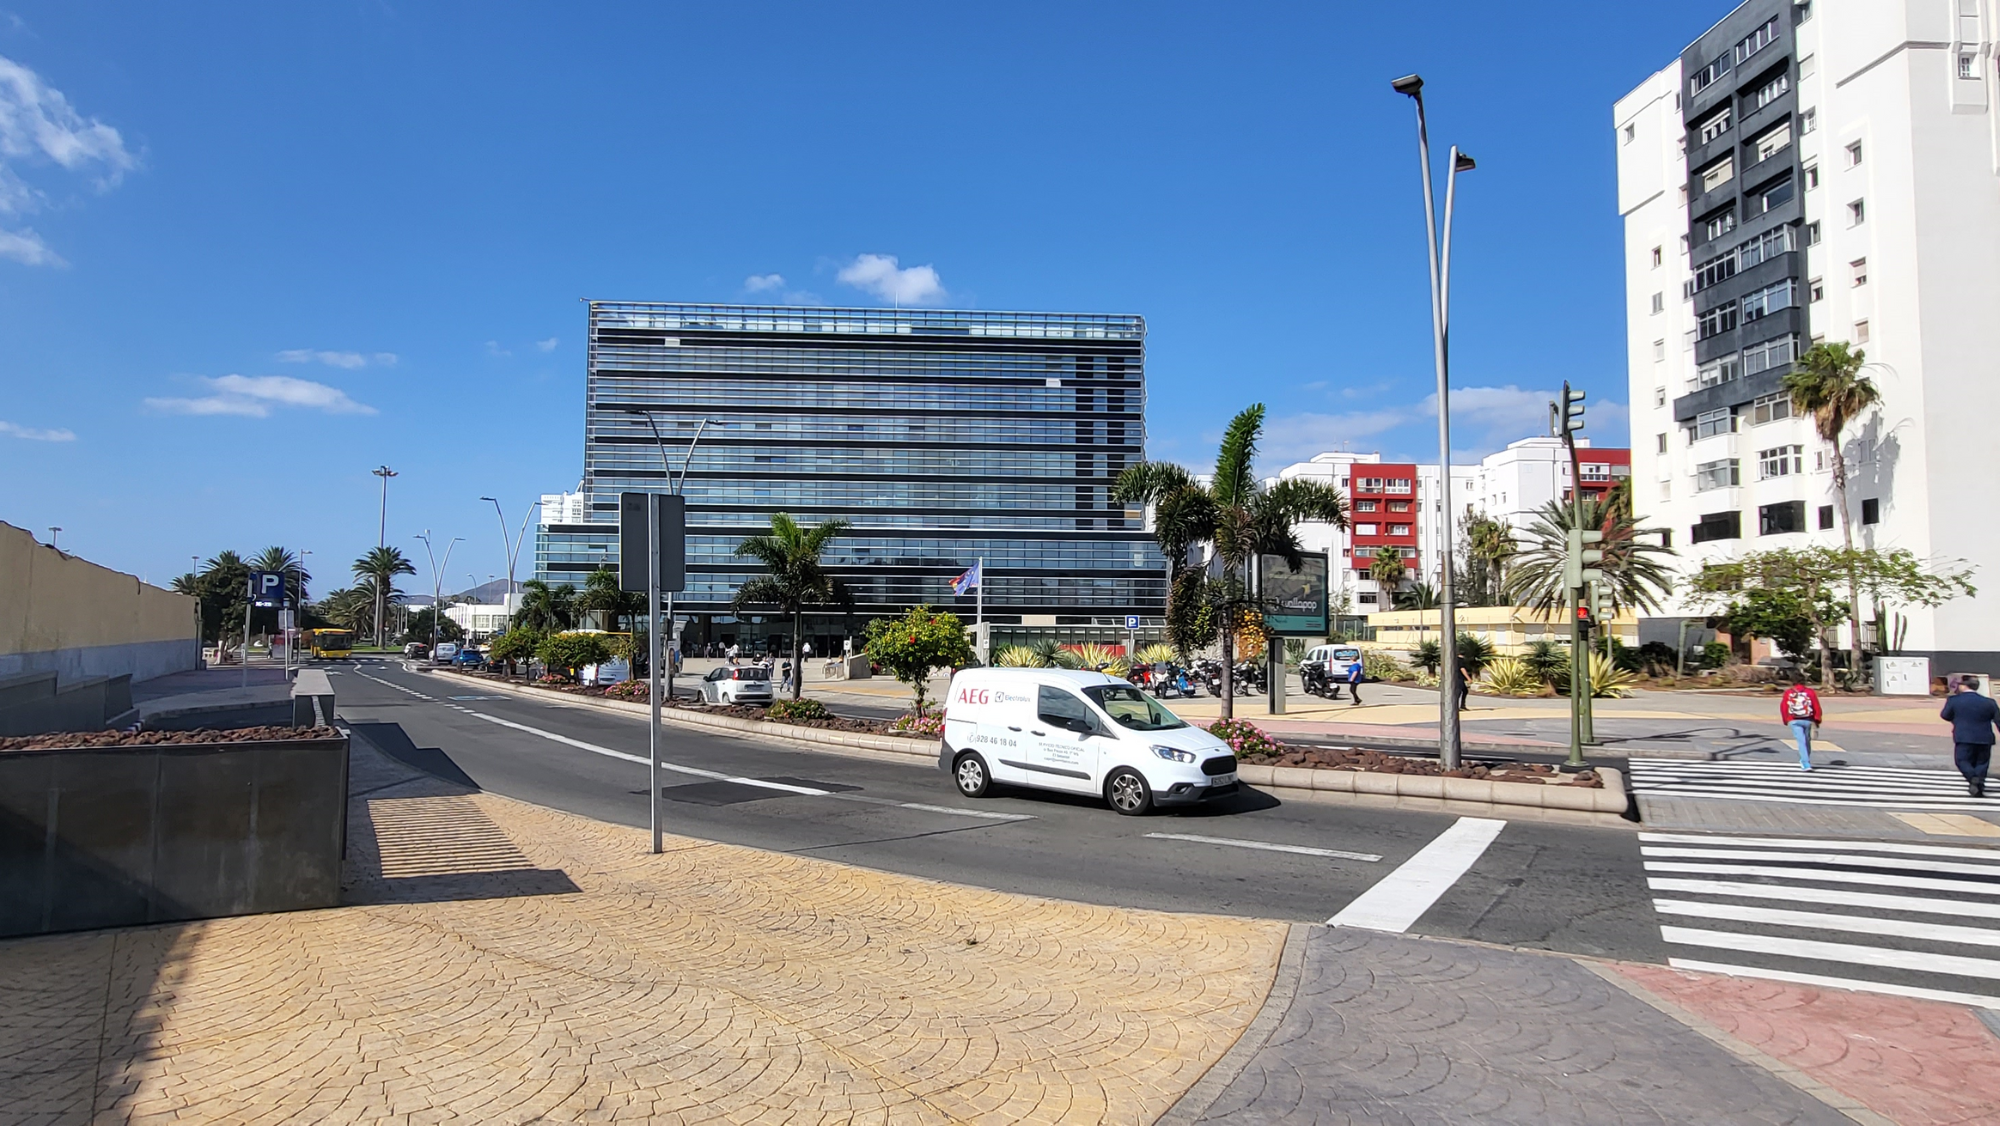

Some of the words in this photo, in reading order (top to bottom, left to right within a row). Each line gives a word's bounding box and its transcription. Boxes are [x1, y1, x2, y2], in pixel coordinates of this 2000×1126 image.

[262, 574, 279, 594] P
[1128, 617, 1137, 627] P
[958, 688, 990, 704] AEG
[976, 734, 989, 744] 928
[990, 736, 998, 745] 46
[1000, 738, 1007, 746] 18
[1009, 739, 1017, 748] 04
